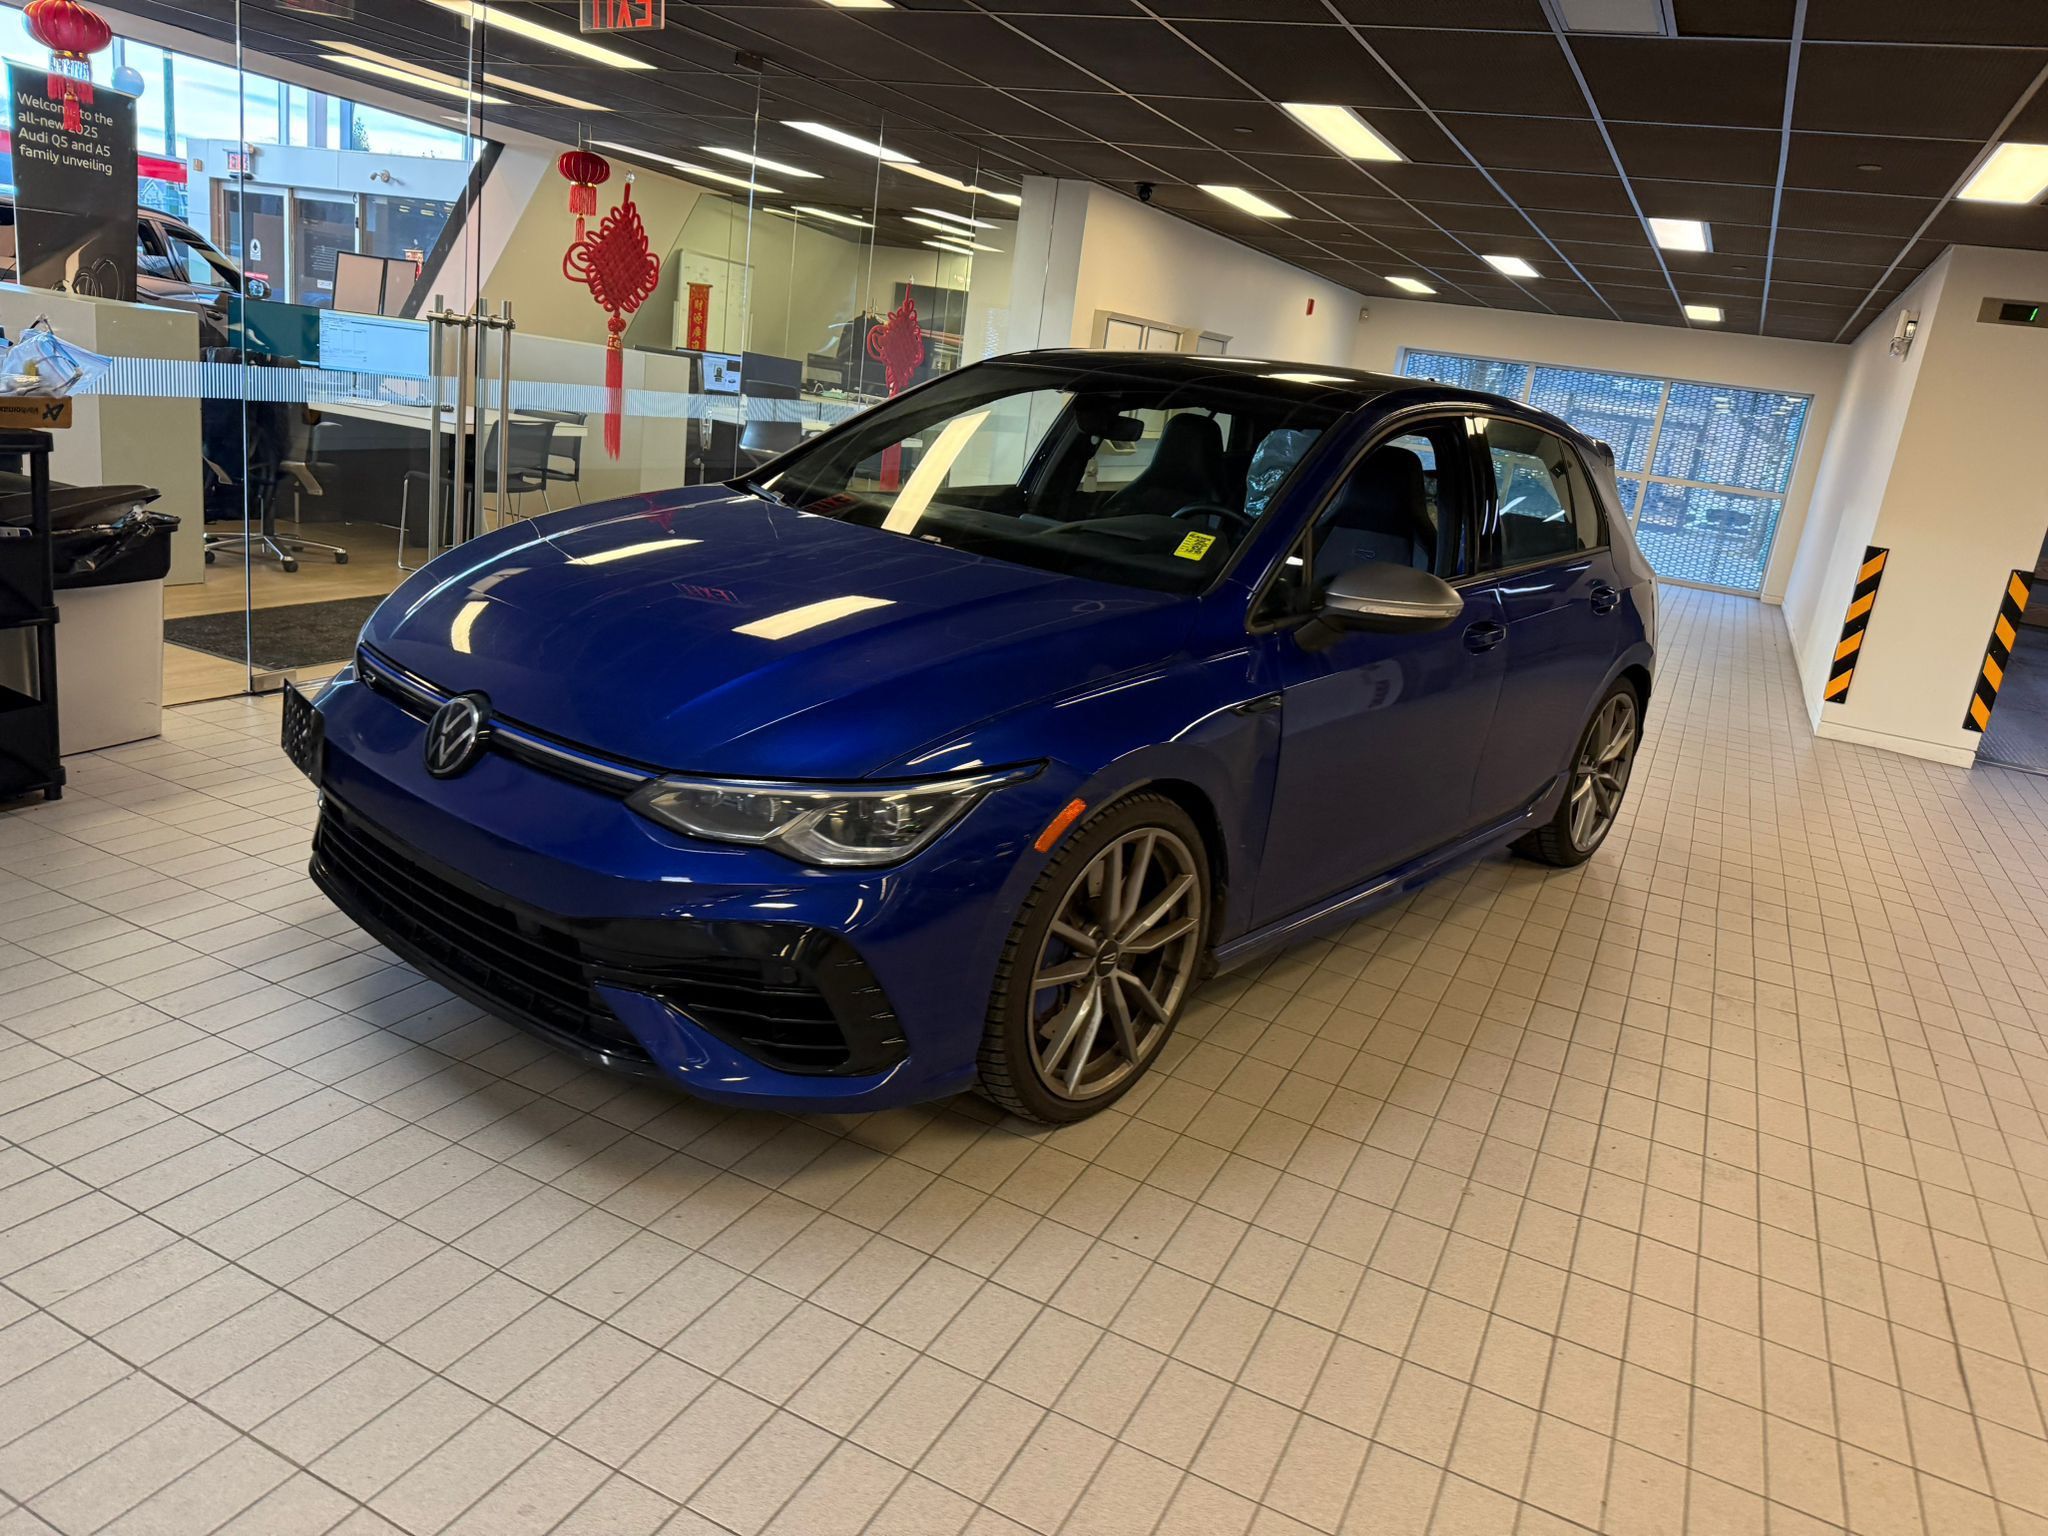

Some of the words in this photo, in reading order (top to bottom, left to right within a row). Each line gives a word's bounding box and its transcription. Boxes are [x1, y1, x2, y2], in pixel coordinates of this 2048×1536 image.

[17, 91, 77, 116] Welcom
[80, 110, 92, 121] to
[94, 112, 113, 126] the
[18, 111, 65, 130] all-new
[18, 127, 48, 144] Audi
[51, 134, 68, 148] Q5
[71, 139, 93, 153] and
[95, 144, 111, 157] A5
[19, 144, 60, 165] family
[62, 154, 113, 176] unveiling
